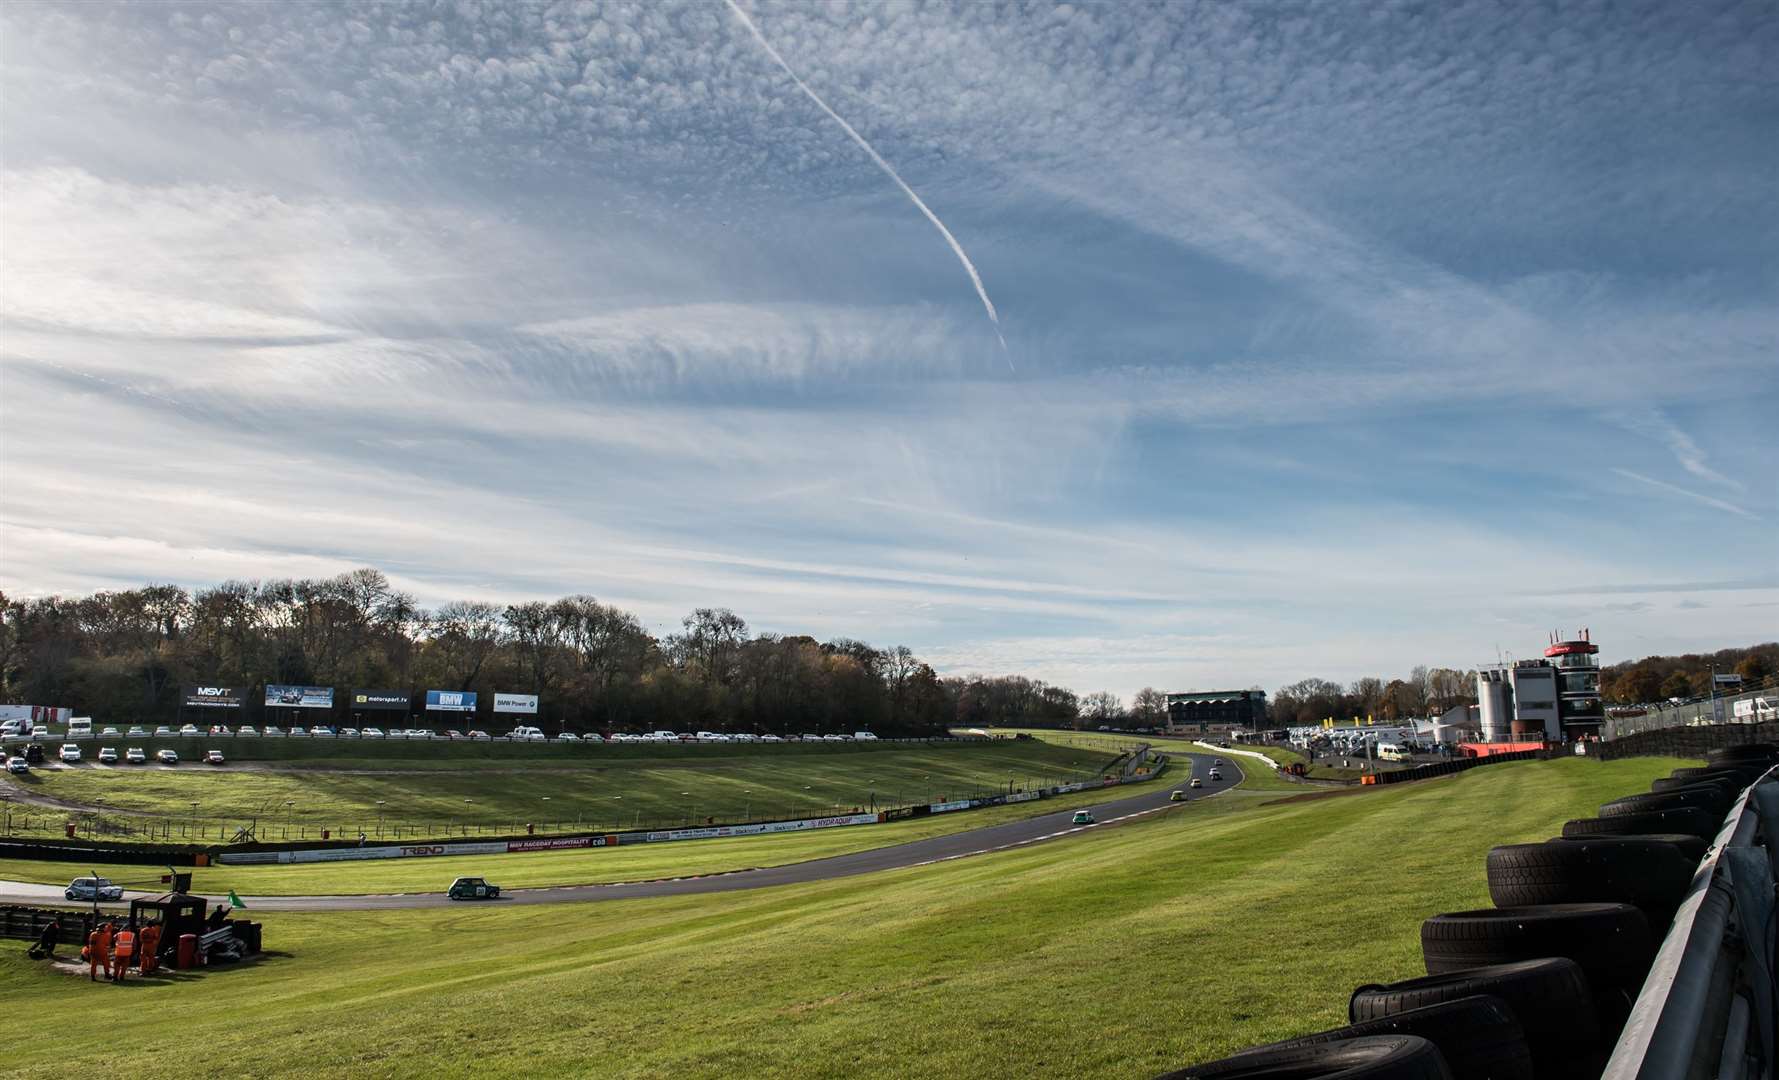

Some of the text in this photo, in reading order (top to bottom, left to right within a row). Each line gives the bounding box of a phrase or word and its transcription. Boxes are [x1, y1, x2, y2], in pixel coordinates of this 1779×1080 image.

[198, 687, 232, 696] MSVT
[440, 693, 463, 705] BMW
[400, 846, 444, 856] TREND
